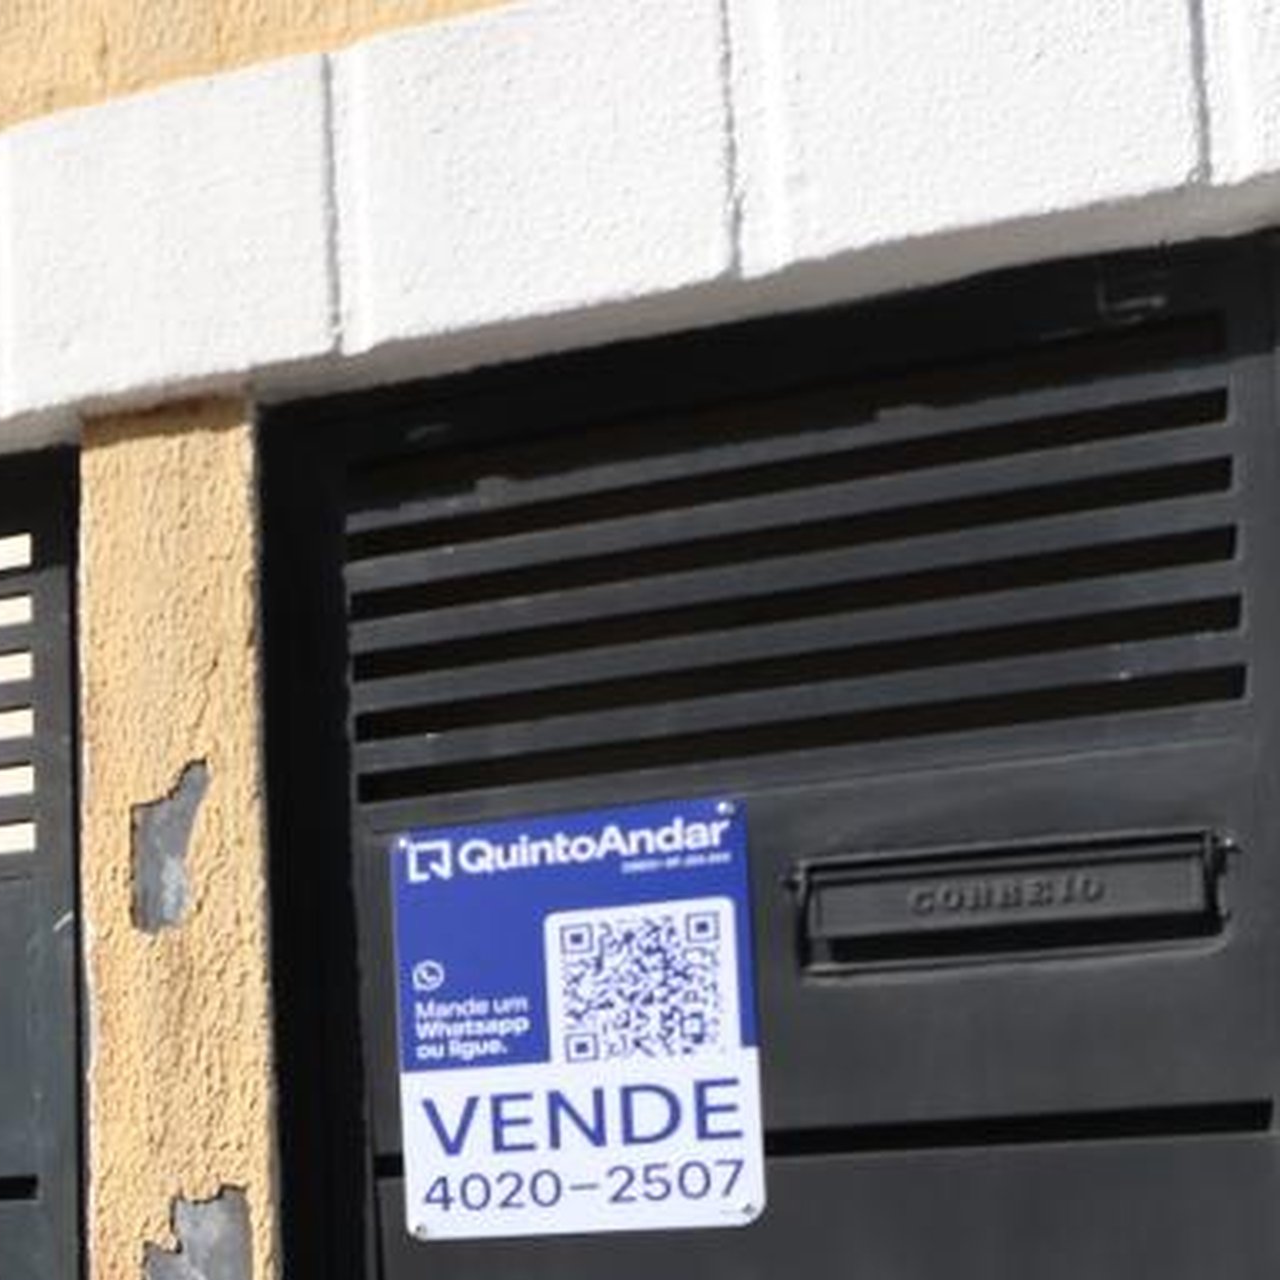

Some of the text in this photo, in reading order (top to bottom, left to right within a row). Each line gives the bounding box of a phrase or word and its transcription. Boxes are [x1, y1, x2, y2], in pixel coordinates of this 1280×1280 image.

[458, 817, 732, 875] QuintoAndar
[415, 997, 529, 1019] Mande um
[416, 1039, 508, 1061] ou ligue.
[421, 1077, 744, 1157] VENDE
[423, 1159, 746, 1212] 4020-2507
